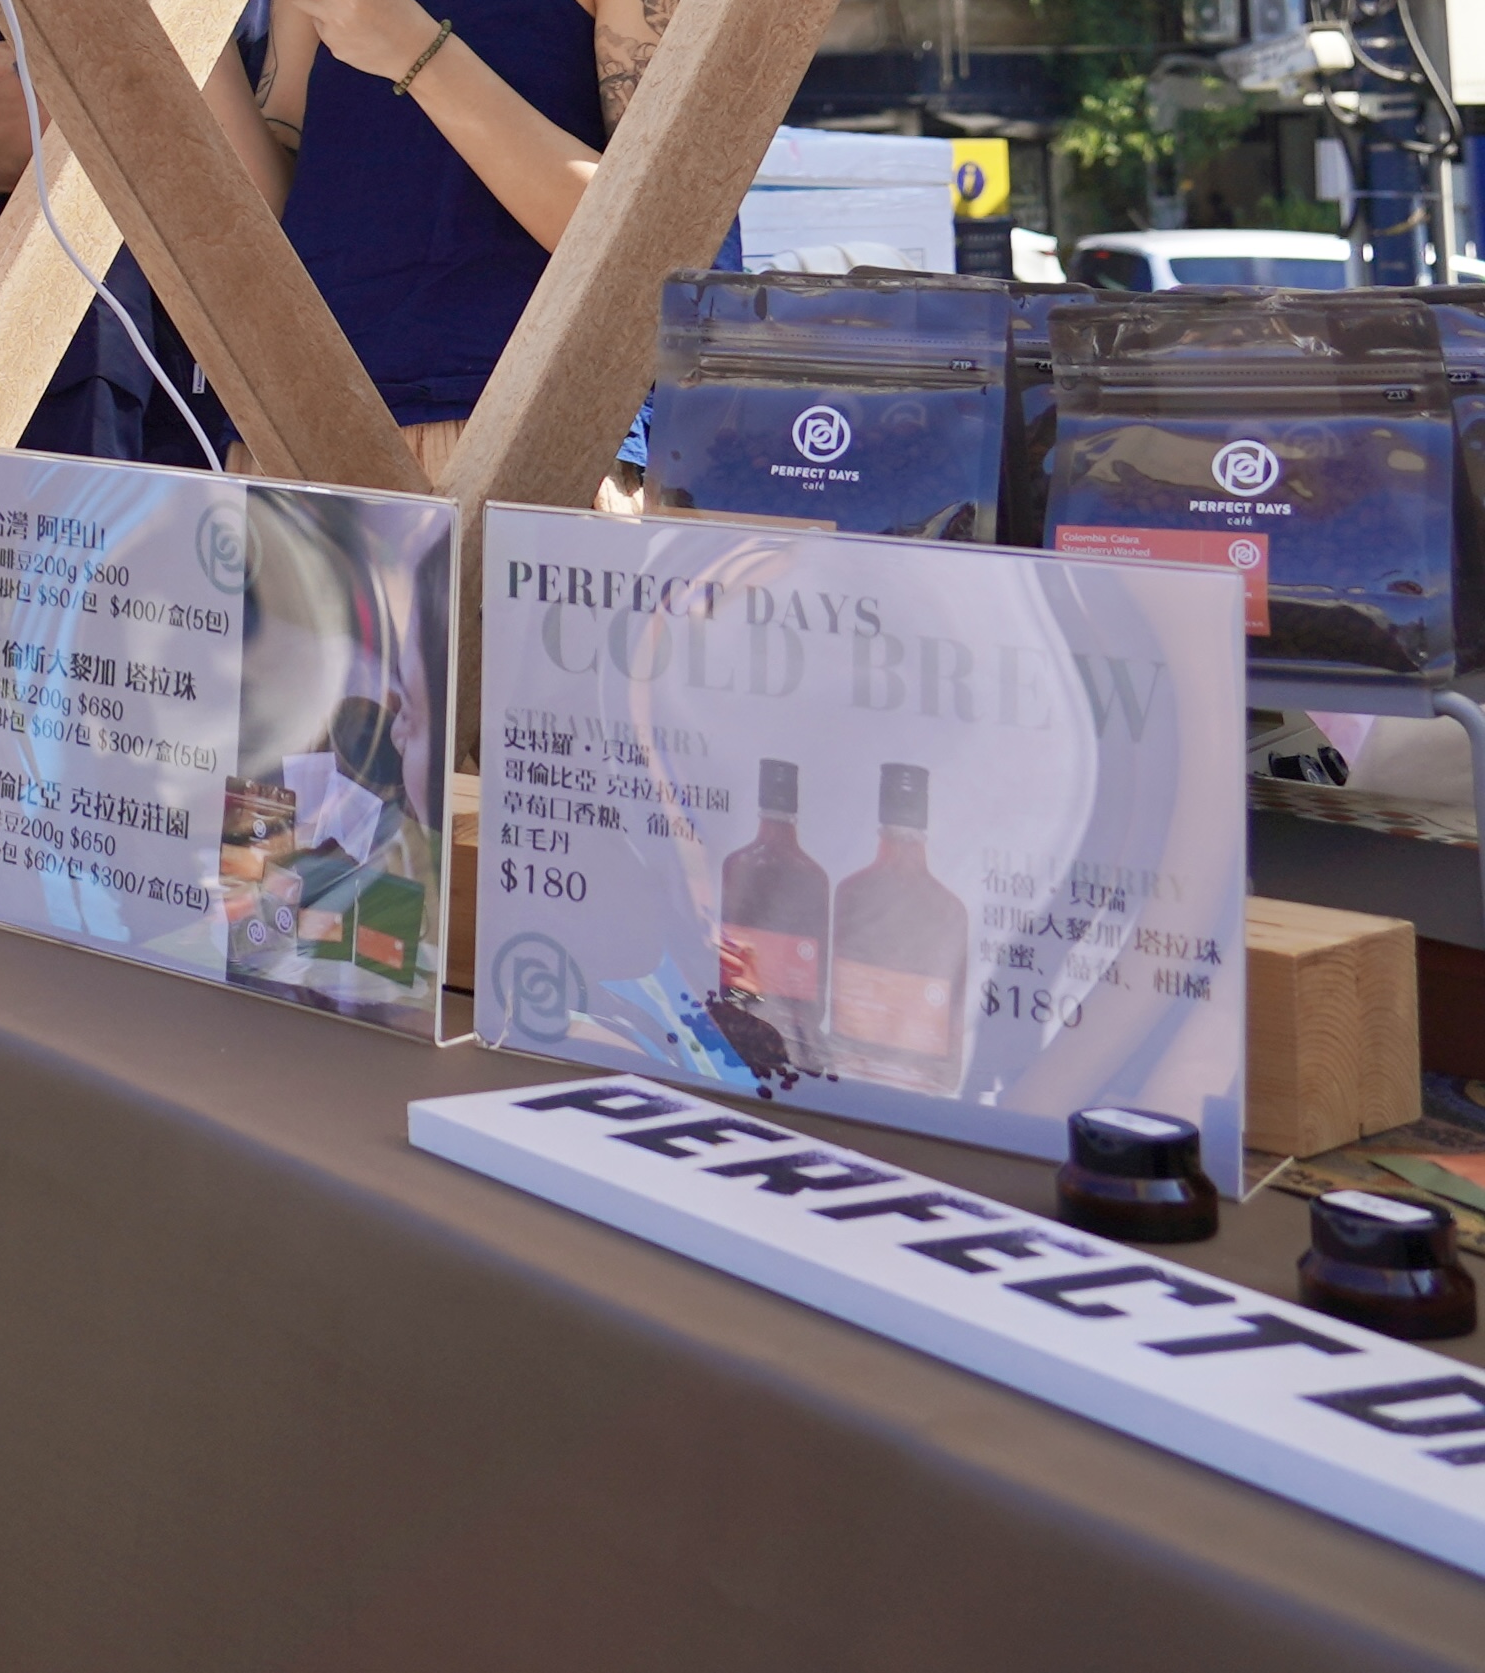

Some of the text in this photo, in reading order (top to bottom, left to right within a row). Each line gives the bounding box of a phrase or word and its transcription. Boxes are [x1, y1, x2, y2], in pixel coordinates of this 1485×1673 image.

[951, 361, 973, 370] ZIP
[1449, 373, 1472, 383] ZIP
[1386, 390, 1407, 400] ZIP
[770, 464, 859, 482] PERFECT DAYS
[803, 479, 825, 491] café
[1189, 500, 1291, 516] PERFECT DAYS
[1227, 516, 1253, 526] café
[36, 514, 105, 551] 阿里山
[1062, 532, 1106, 543] Colombia
[1061, 544, 1150, 557] Strawberry Washed
[83, 560, 129, 587] $800
[37, 583, 98, 614] $80/包
[109, 594, 230, 636] $400/盒(5包)
[507, 560, 882, 637] PERFECT DAYS
[124, 660, 197, 702] 塔拉珠
[542, 599, 1167, 744] COLD BREW
[78, 692, 123, 721] $680
[32, 714, 91, 747] $60/包
[98, 728, 217, 773] $300/盒(5包)
[505, 758, 729, 813] 哥倫比亞 克拉拉莊園
[71, 786, 190, 839] 克拉拉莊園
[70, 826, 116, 856] $650
[501, 822, 570, 854] 紅毛丹
[24, 847, 83, 880] $60/包
[90, 862, 210, 913] $300/盒(5包)
[500, 857, 587, 903] $180
[1134, 927, 1222, 966] 塔拉珠
[1153, 967, 1211, 1002] 柑橘
[980, 977, 1083, 1029] $180
[512, 1085, 1485, 1478] PERFECT D
